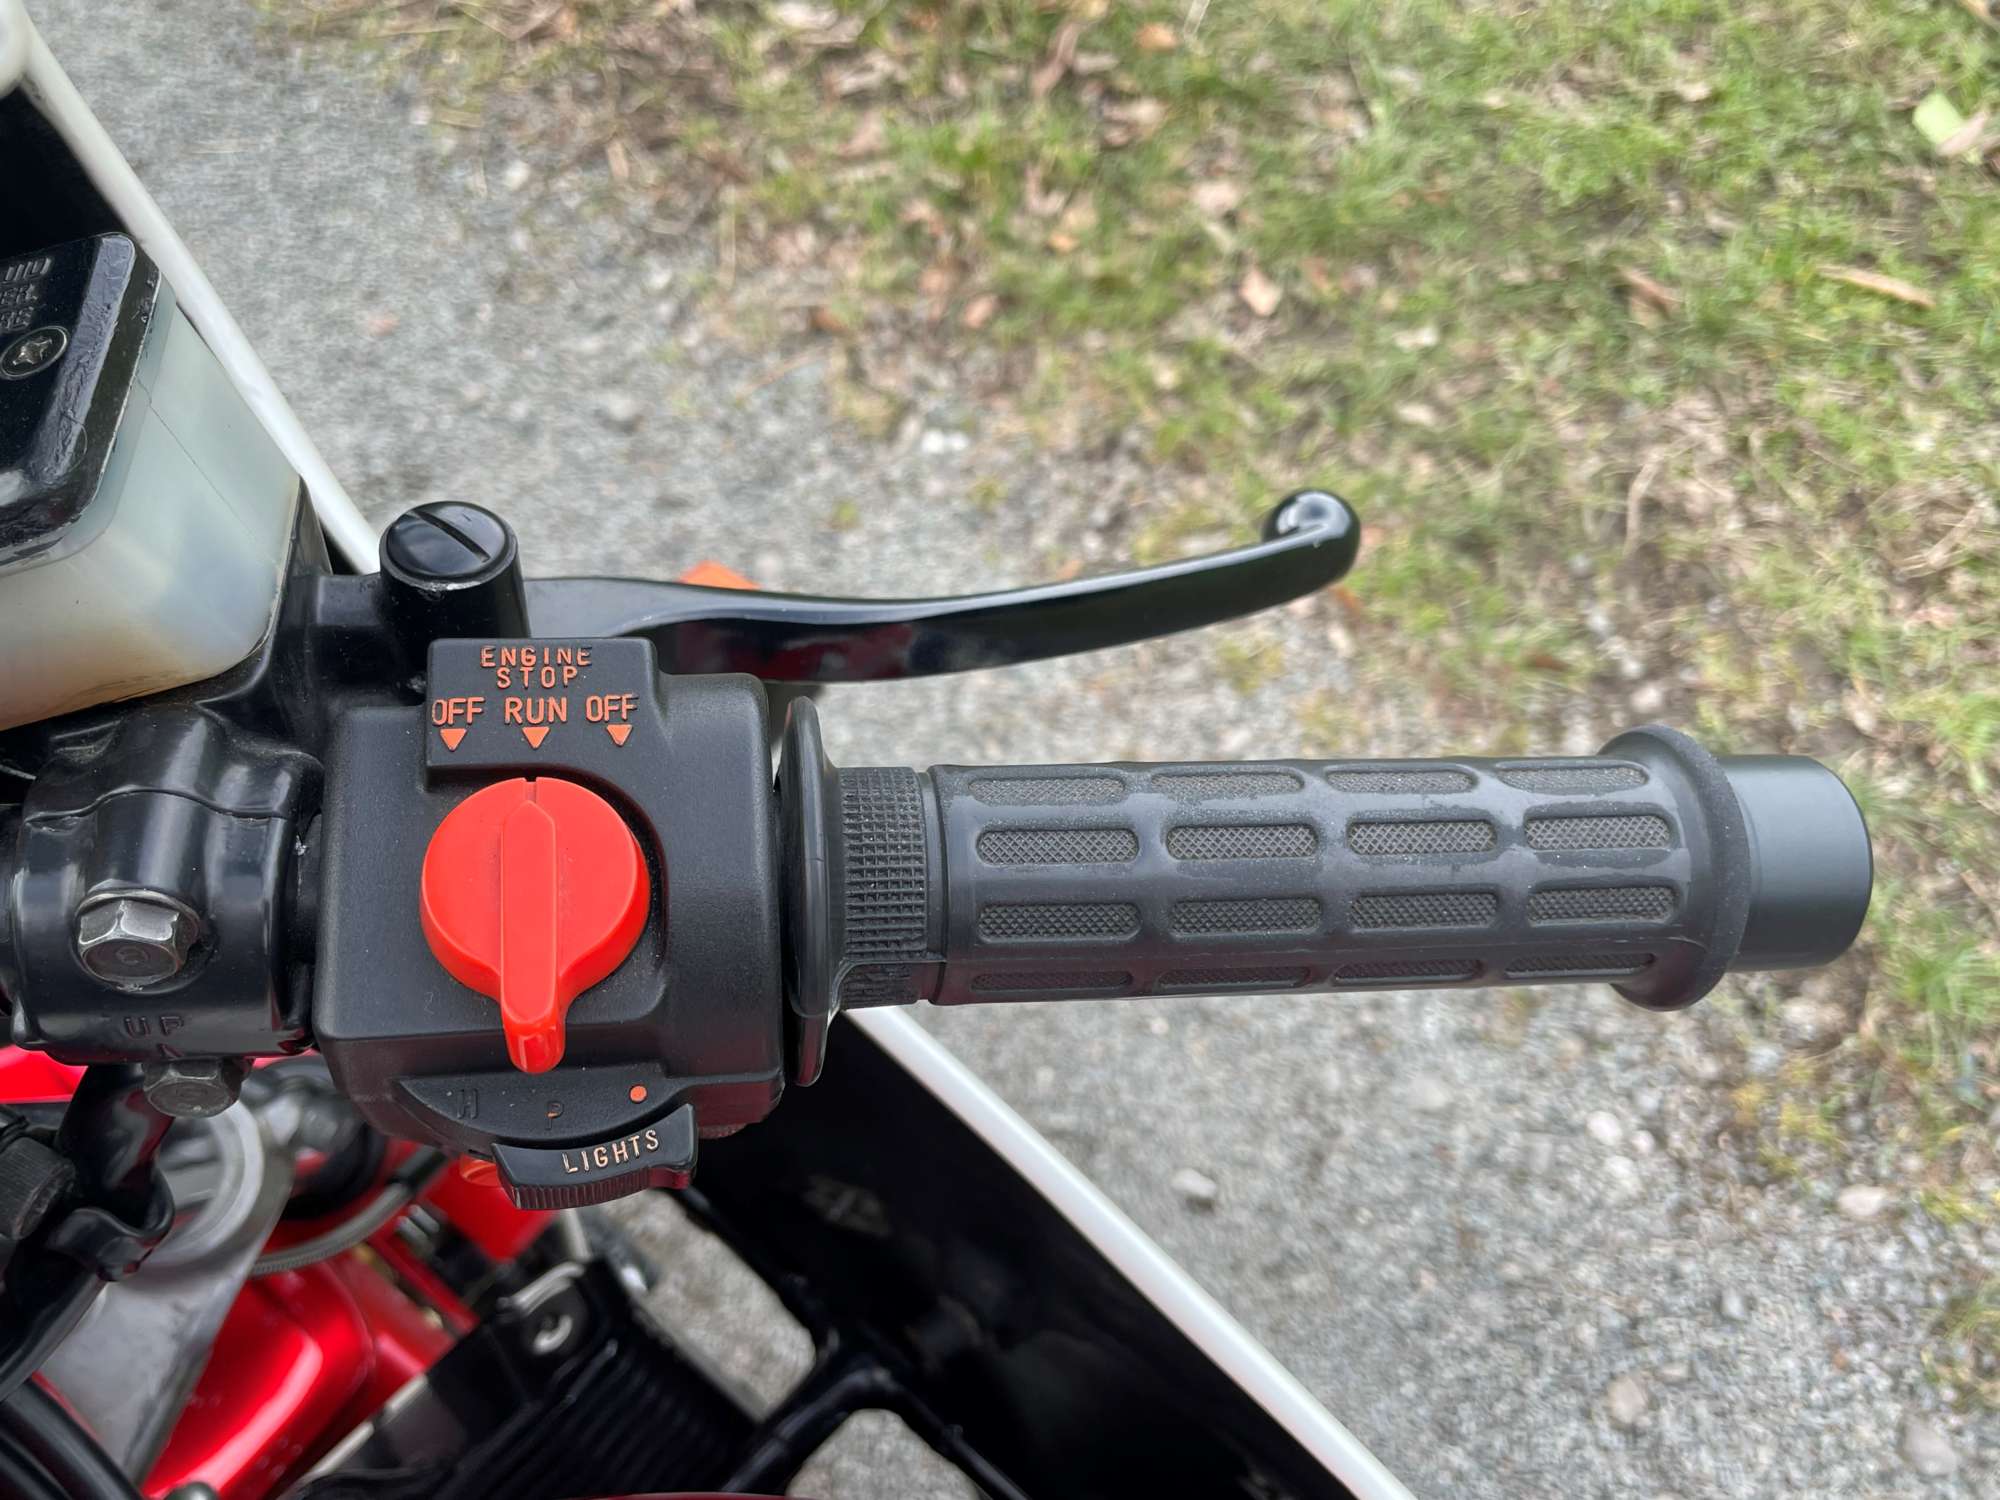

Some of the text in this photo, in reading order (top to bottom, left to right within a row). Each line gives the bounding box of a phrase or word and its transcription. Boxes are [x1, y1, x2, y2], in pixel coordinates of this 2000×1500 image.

[480, 646, 593, 667] ENGINE
[496, 666, 578, 689] STOP
[431, 693, 639, 726] OFF RUN OFF
[124, 1015, 184, 1040] UP
[562, 1129, 660, 1174] LIGHTS
